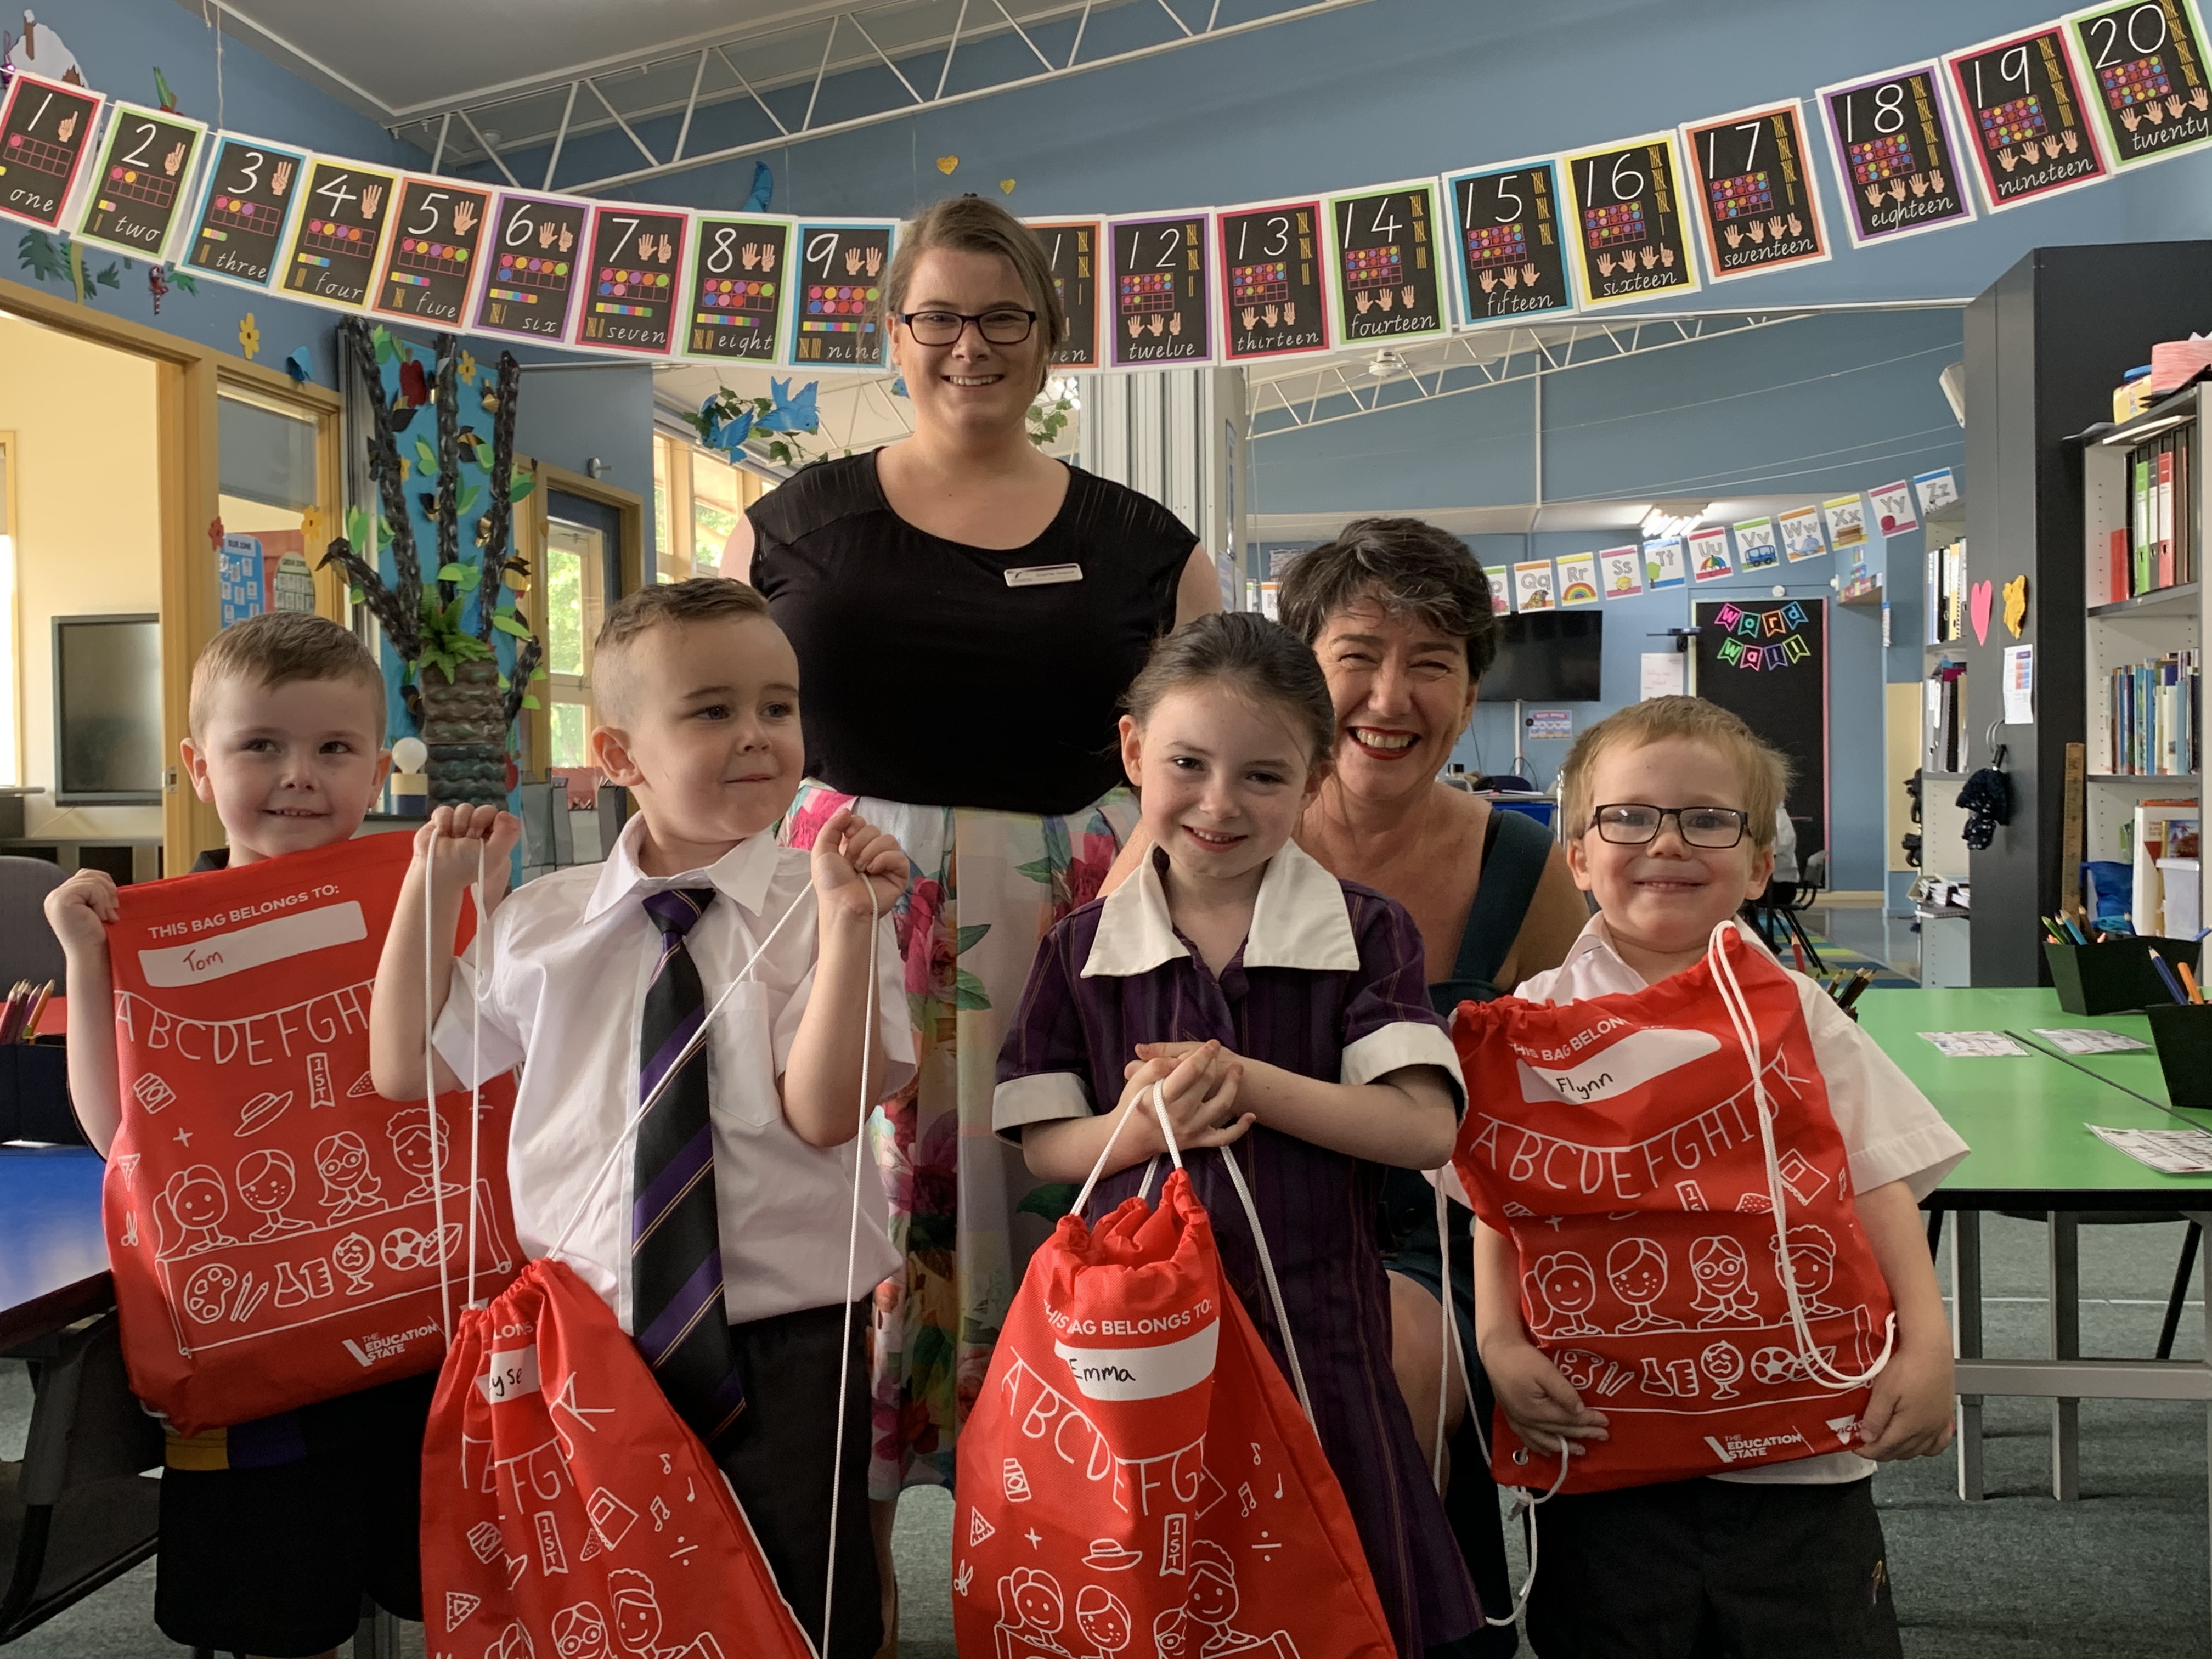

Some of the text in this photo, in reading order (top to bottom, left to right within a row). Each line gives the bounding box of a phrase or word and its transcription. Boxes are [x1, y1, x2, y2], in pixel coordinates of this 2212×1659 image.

[2090, 4, 2167, 70] 20
[1974, 46, 2030, 109] 19
[27, 93, 53, 131] 1
[1847, 83, 1904, 143] 18
[121, 123, 157, 168] 2
[2132, 116, 2209, 151] twenty
[1708, 122, 1760, 179] 17
[227, 151, 264, 195] 3
[1587, 153, 1644, 207] 16
[1997, 156, 2093, 195] nineteen
[9, 187, 55, 213] one
[315, 174, 357, 218] 4
[1465, 174, 1522, 229] 15
[407, 192, 449, 235] 5
[505, 204, 534, 247] 6
[1344, 197, 1403, 249] 14
[1871, 196, 1953, 231] eighteen
[114, 214, 161, 241] two
[608, 218, 639, 263] 7
[1238, 217, 1289, 260] 13
[707, 228, 737, 273] 8
[806, 233, 839, 278] 9
[1129, 228, 1180, 269] 12
[1724, 237, 1813, 267] seventeen
[215, 251, 268, 279] three
[314, 272, 364, 301] four
[1603, 269, 1677, 296] sixteen
[415, 289, 458, 319] five
[1487, 290, 1554, 316] fifteen
[522, 314, 557, 334] six
[606, 324, 667, 345] seven
[1350, 312, 1436, 338] fourteen
[717, 331, 774, 358] eight
[827, 345, 880, 360] nine
[1128, 334, 1195, 360] twelve
[1237, 330, 1319, 352] thirteen
[1880, 495, 1906, 514] Yy
[1926, 483, 1950, 500] Zz
[1783, 520, 1818, 538] Ww
[1834, 509, 1861, 527] Xx
[1700, 541, 1723, 558] Uu
[1741, 531, 1770, 549] Vv
[1612, 560, 1632, 576] Ss
[1655, 549, 1674, 567] Tt
[1521, 573, 1551, 590] Qq
[1567, 567, 1588, 582] Rr
[1722, 606, 1799, 631] Word
[1724, 640, 1802, 662] Wall
[148, 884, 340, 939] THIS BAG BELONGS TO:
[183, 950, 223, 972] Tom
[1510, 1017, 1628, 1062] HIS BAG BELON
[1556, 1073, 1613, 1100] Flynn
[1043, 1299, 1070, 1329] HIS
[1102, 1310, 1190, 1335] BELONGS
[1194, 1299, 1212, 1318] TO:
[362, 1333, 380, 1343] THE
[364, 1323, 438, 1352] EDUCATION
[367, 1344, 405, 1361] STATE
[1069, 1358, 1136, 1383] Emma
[1726, 1434, 1802, 1451] EDUCATION
[1728, 1448, 1767, 1459] STATE
